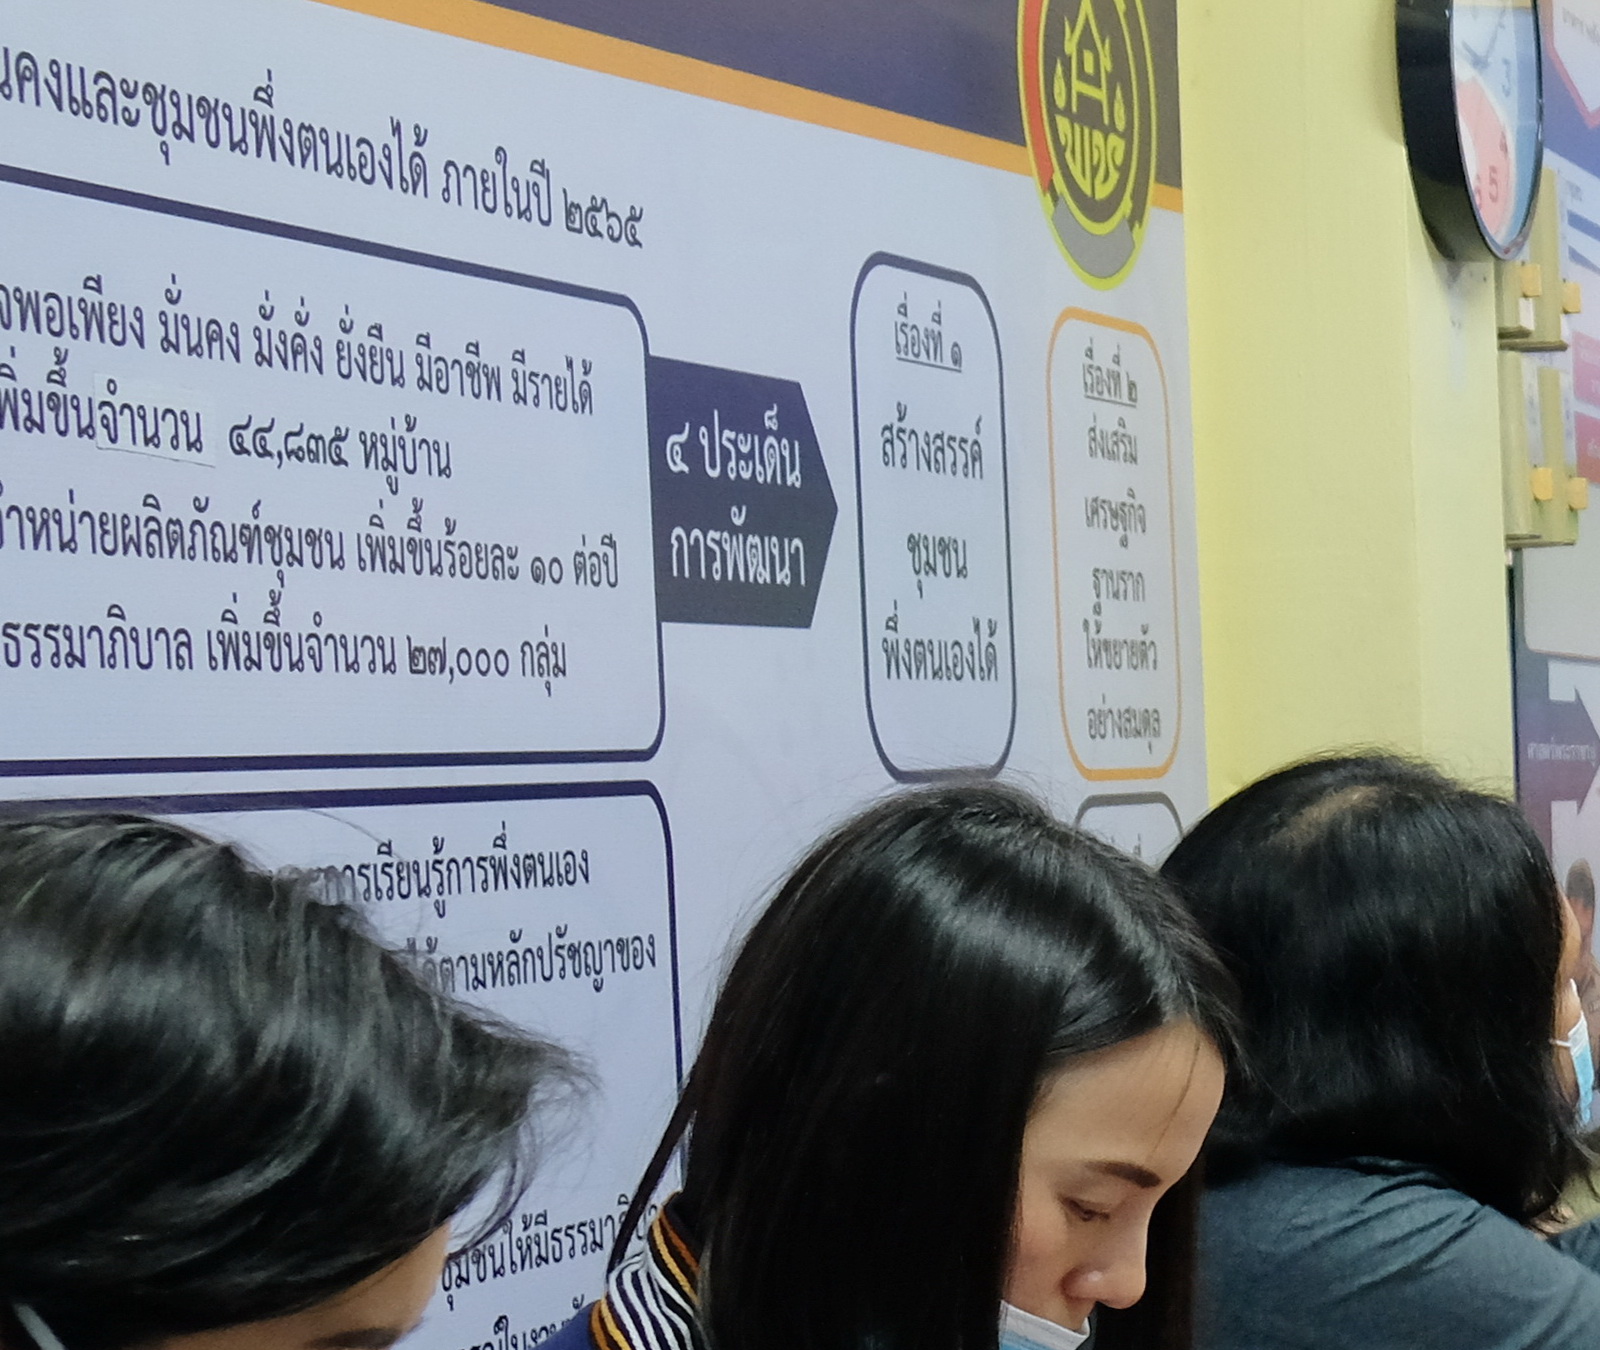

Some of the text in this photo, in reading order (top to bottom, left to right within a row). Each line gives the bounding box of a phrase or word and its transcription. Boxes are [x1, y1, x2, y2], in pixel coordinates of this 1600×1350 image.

[441, 146, 552, 227] ภายในปี
[158, 272, 241, 363] มั่นคง
[253, 290, 324, 375] มั่งคั่ง
[335, 303, 406, 389] ยั่งยืน
[416, 332, 502, 402] มีอาชีพ
[512, 349, 594, 415] มีรายได้
[893, 292, 944, 363] เรื่องที่
[358, 413, 453, 496] หมู่บ้าน
[665, 404, 802, 489] ๔ ประเด็น
[880, 402, 985, 481] สร้างสรรค์
[1087, 417, 1139, 466] ส่งเสริม
[0, 479, 345, 588] ำหน่ายผลิตภัณฑ์ชุมชน
[356, 498, 519, 582] เพิ่มขึ้นร้อยละ
[572, 533, 620, 589] ต่อปี
[669, 505, 806, 587] การพัฒนา
[1084, 487, 1148, 549] เศรษฐกิจ
[906, 532, 969, 600] ชุมชน
[1, 603, 194, 672] ธรรมาภิบาล
[205, 588, 397, 676] เพิ่มขึ้นจำนวน
[519, 625, 568, 697] กลุ่ม
[881, 600, 999, 683] พึ่งตนเองได้
